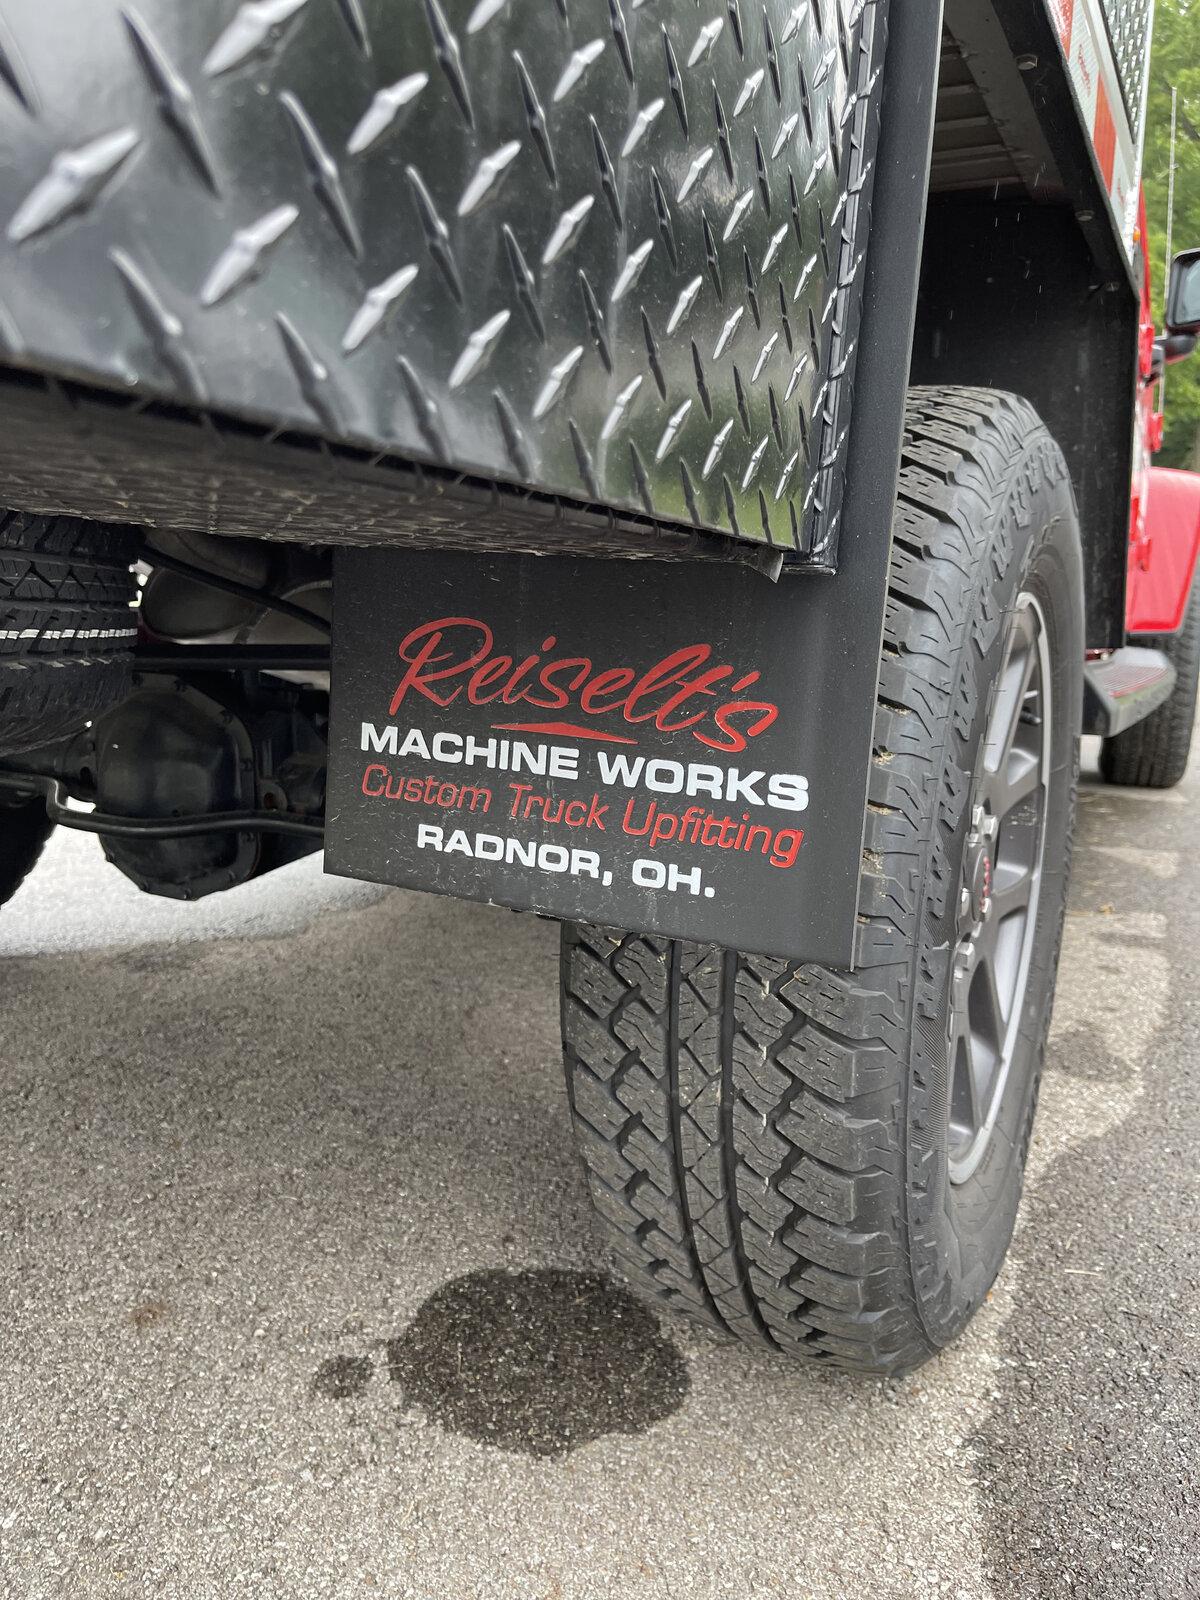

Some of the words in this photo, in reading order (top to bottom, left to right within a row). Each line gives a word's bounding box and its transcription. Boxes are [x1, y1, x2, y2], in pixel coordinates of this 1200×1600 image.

[388, 617, 778, 752] Reiselt's
[360, 722, 580, 780] MACHINE
[597, 750, 810, 812] WORKS
[361, 763, 492, 814] Custom
[508, 782, 608, 831] Truck
[622, 799, 805, 868] Upfitting
[416, 823, 613, 887] RADNOR,
[631, 858, 716, 898] OH.
